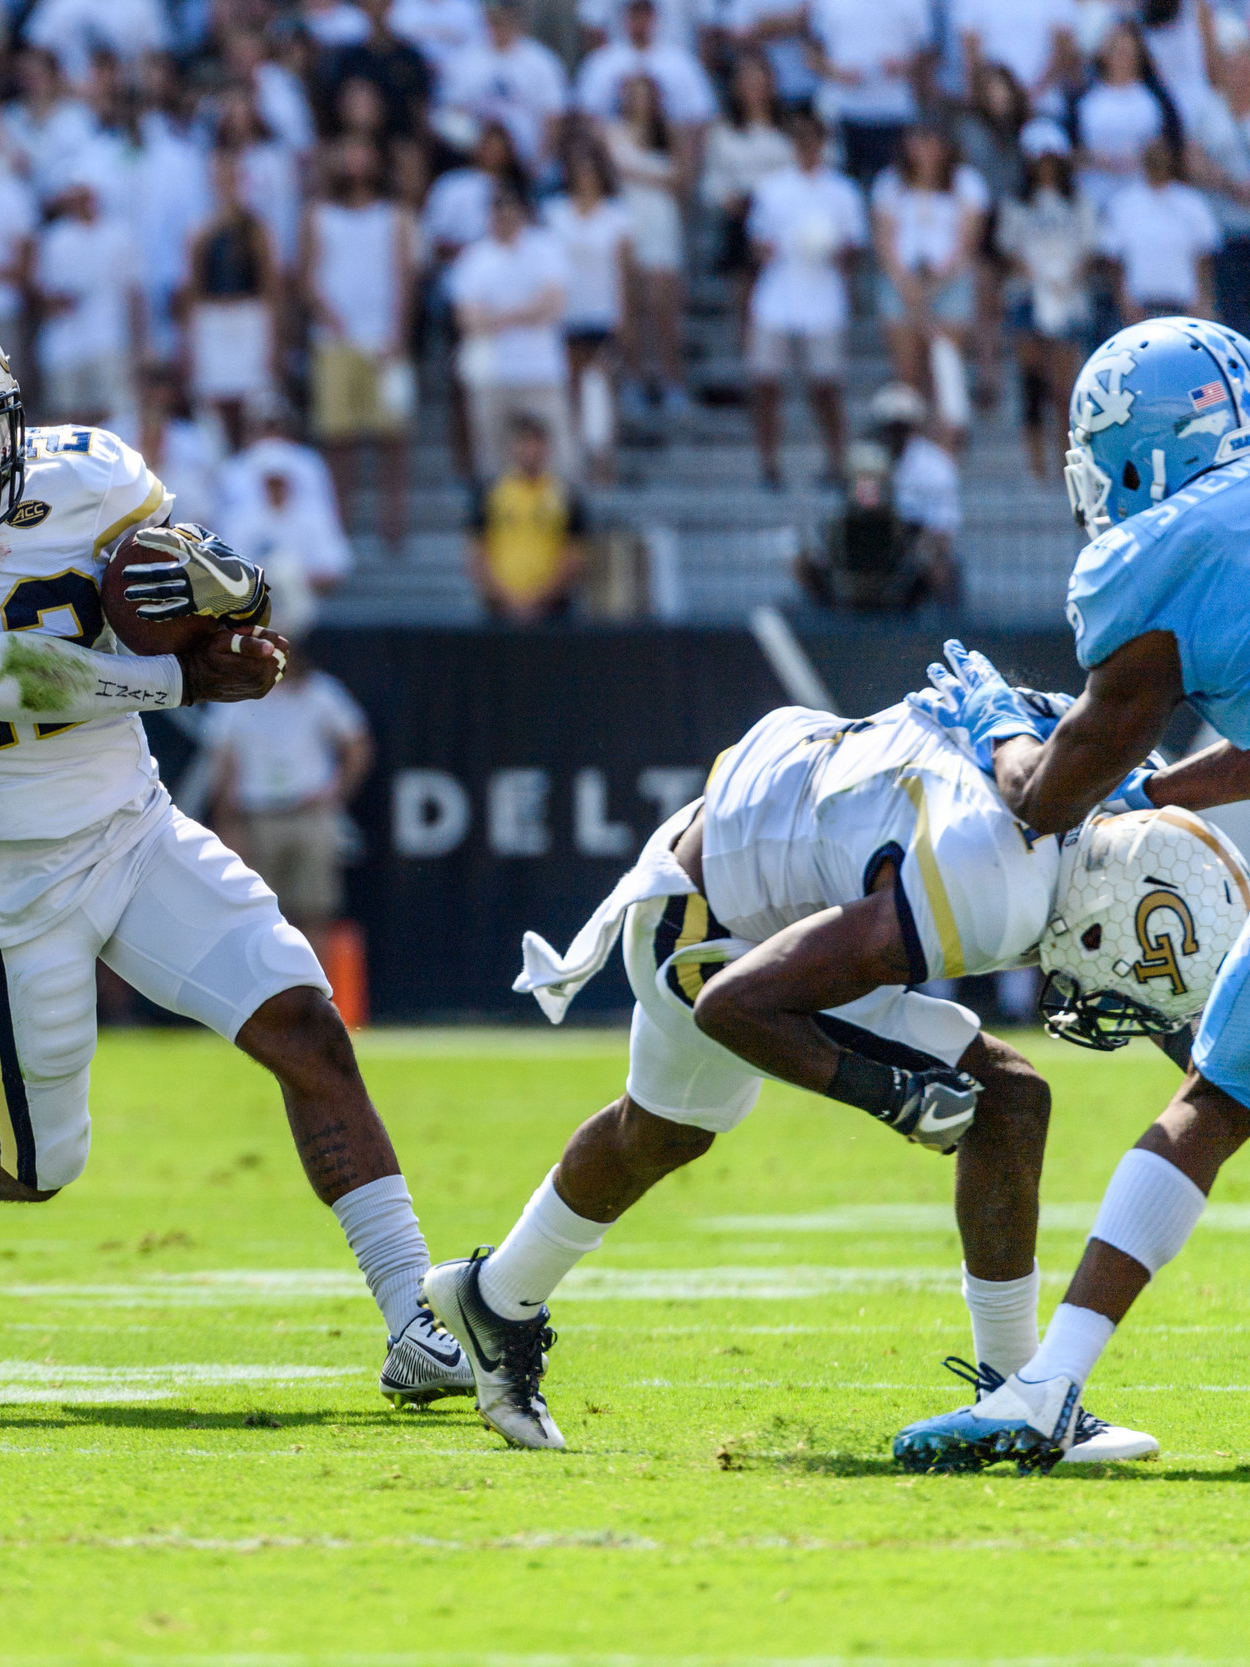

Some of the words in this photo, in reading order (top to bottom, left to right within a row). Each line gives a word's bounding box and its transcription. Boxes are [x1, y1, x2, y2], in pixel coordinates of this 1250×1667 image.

[12, 502, 46, 523] ACC
[393, 766, 707, 858] DELT
[1132, 889, 1200, 996] GT
